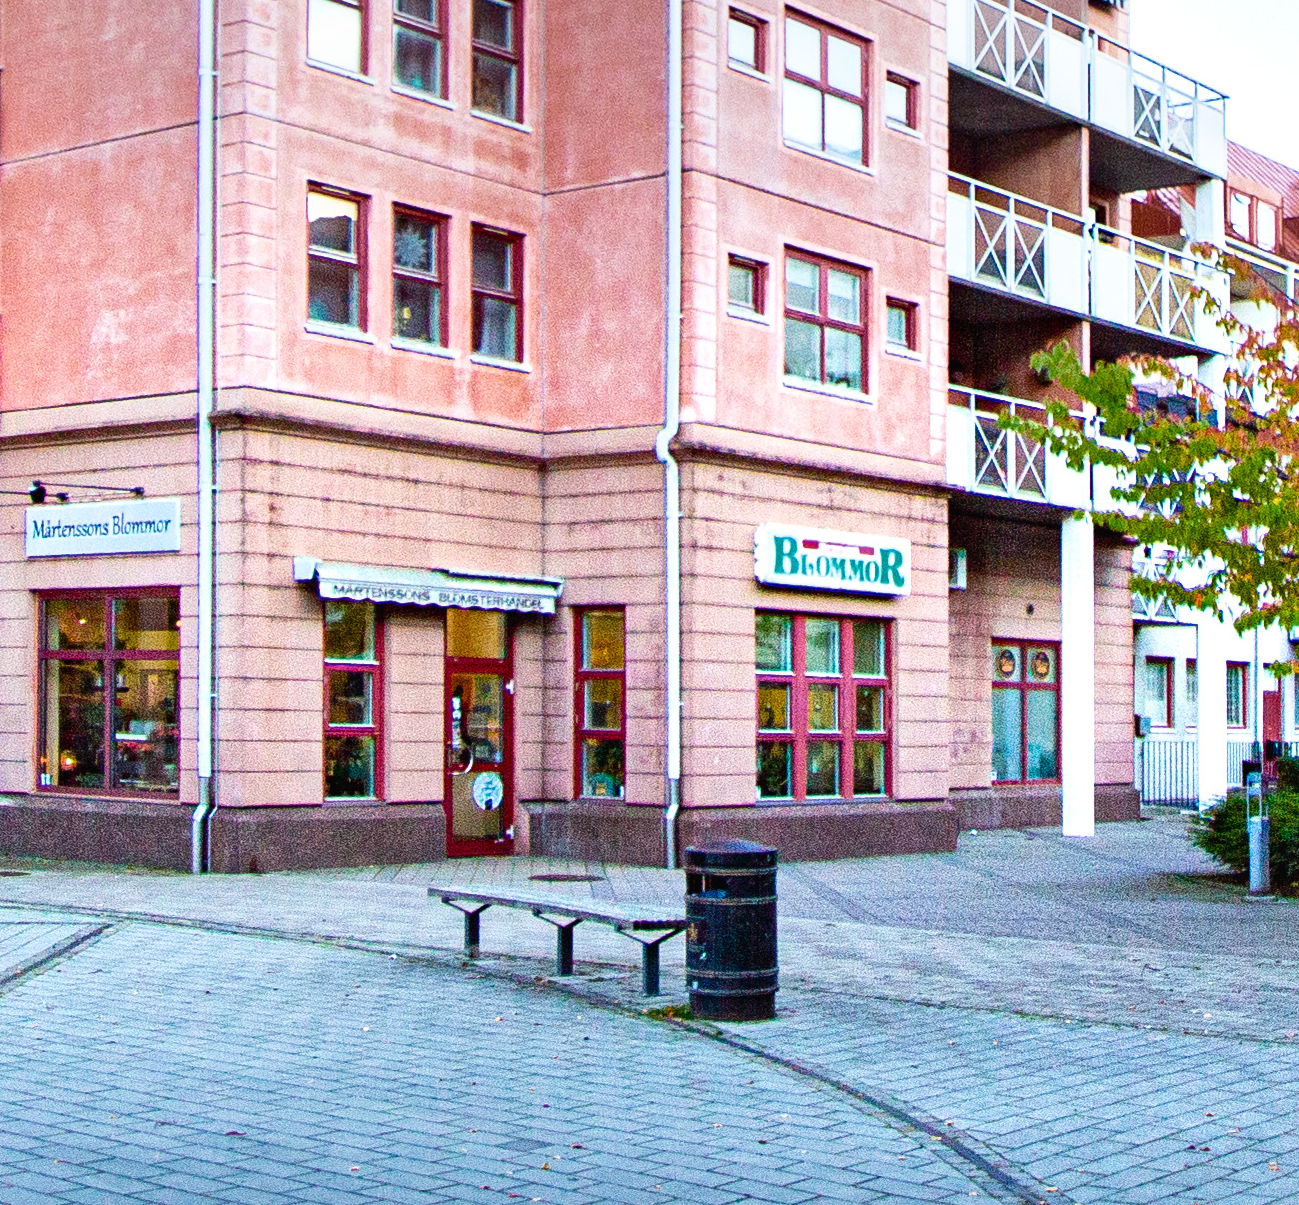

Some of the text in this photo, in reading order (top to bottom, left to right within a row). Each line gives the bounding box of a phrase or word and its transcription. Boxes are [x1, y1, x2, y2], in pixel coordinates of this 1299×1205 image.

[32, 512, 171, 539] Mårtenssons Blommor
[773, 535, 905, 588] BLOMMOR
